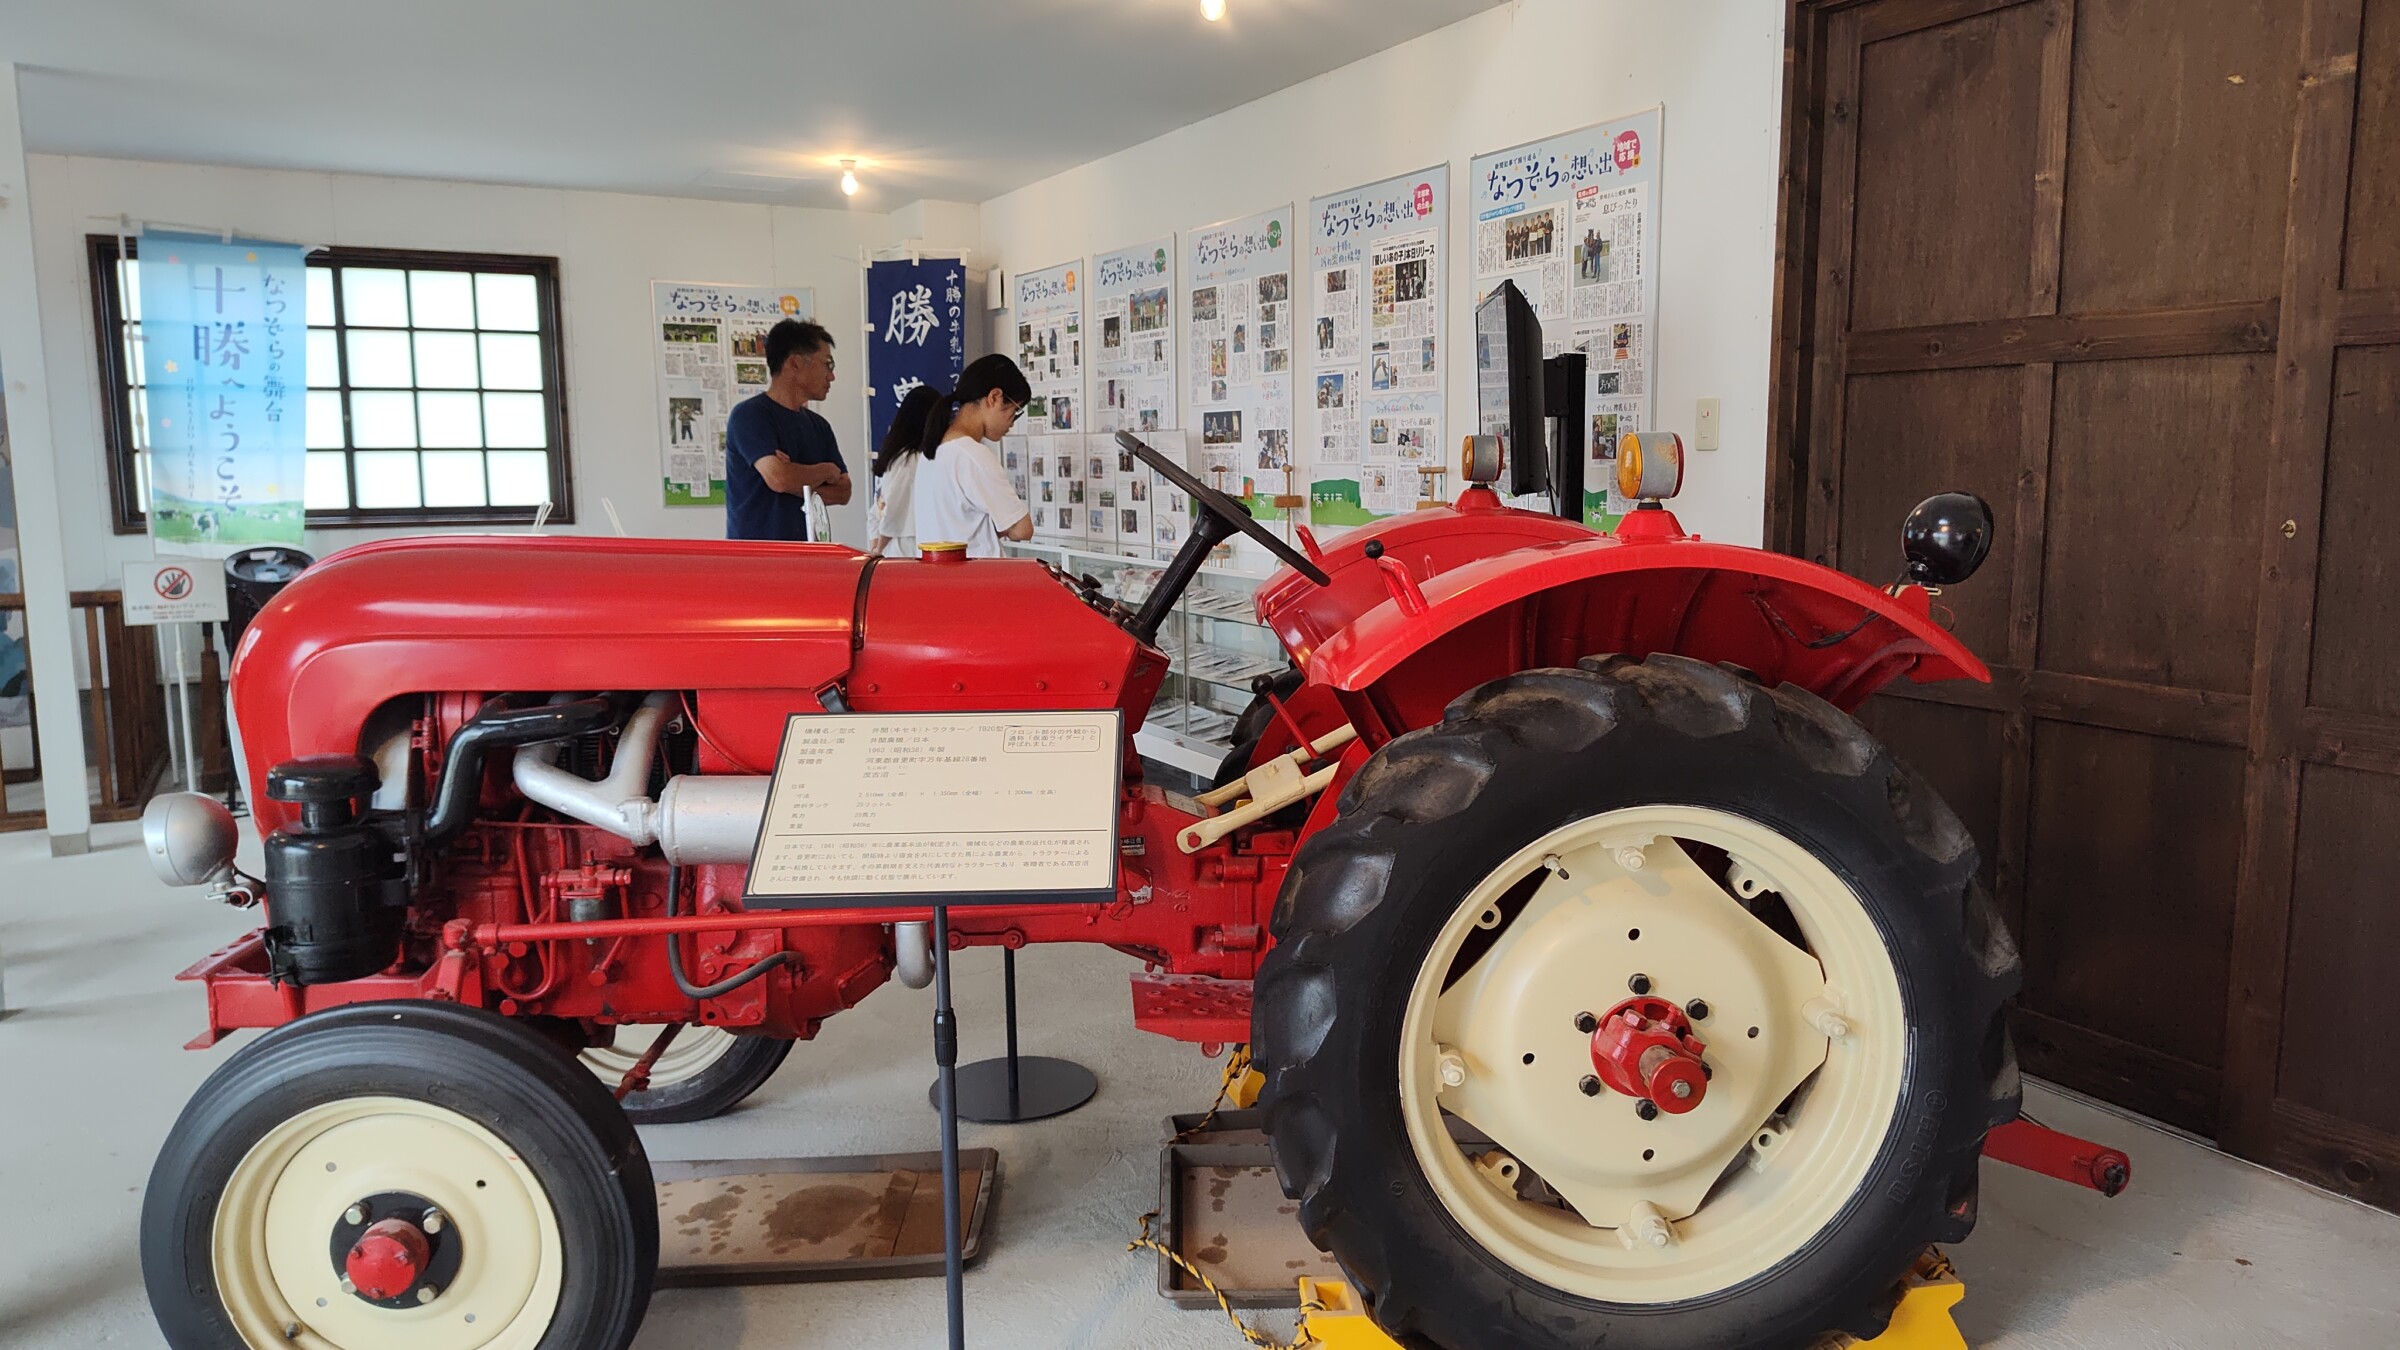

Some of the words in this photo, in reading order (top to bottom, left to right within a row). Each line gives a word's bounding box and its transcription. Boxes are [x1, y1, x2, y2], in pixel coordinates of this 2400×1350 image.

[1616, 138, 1637, 152] 地域で
[1494, 154, 1537, 170] 新聞記事で振り返る
[1489, 151, 1612, 201] なつぞらの想い出
[1322, 200, 1413, 237] なつぞらの想い出
[1197, 234, 1267, 264] なつぞらの想い出
[1372, 245, 1435, 267] 「優しいあの子」本日リリース
[1100, 259, 1155, 286] なつぞらの想い出
[671, 291, 780, 314] なつぞらの想い出
[1021, 279, 1067, 303] なつぞらの想い出
[263, 274, 287, 423] なつぞらの舞台
[192, 266, 250, 512] 十勝へようこそ
